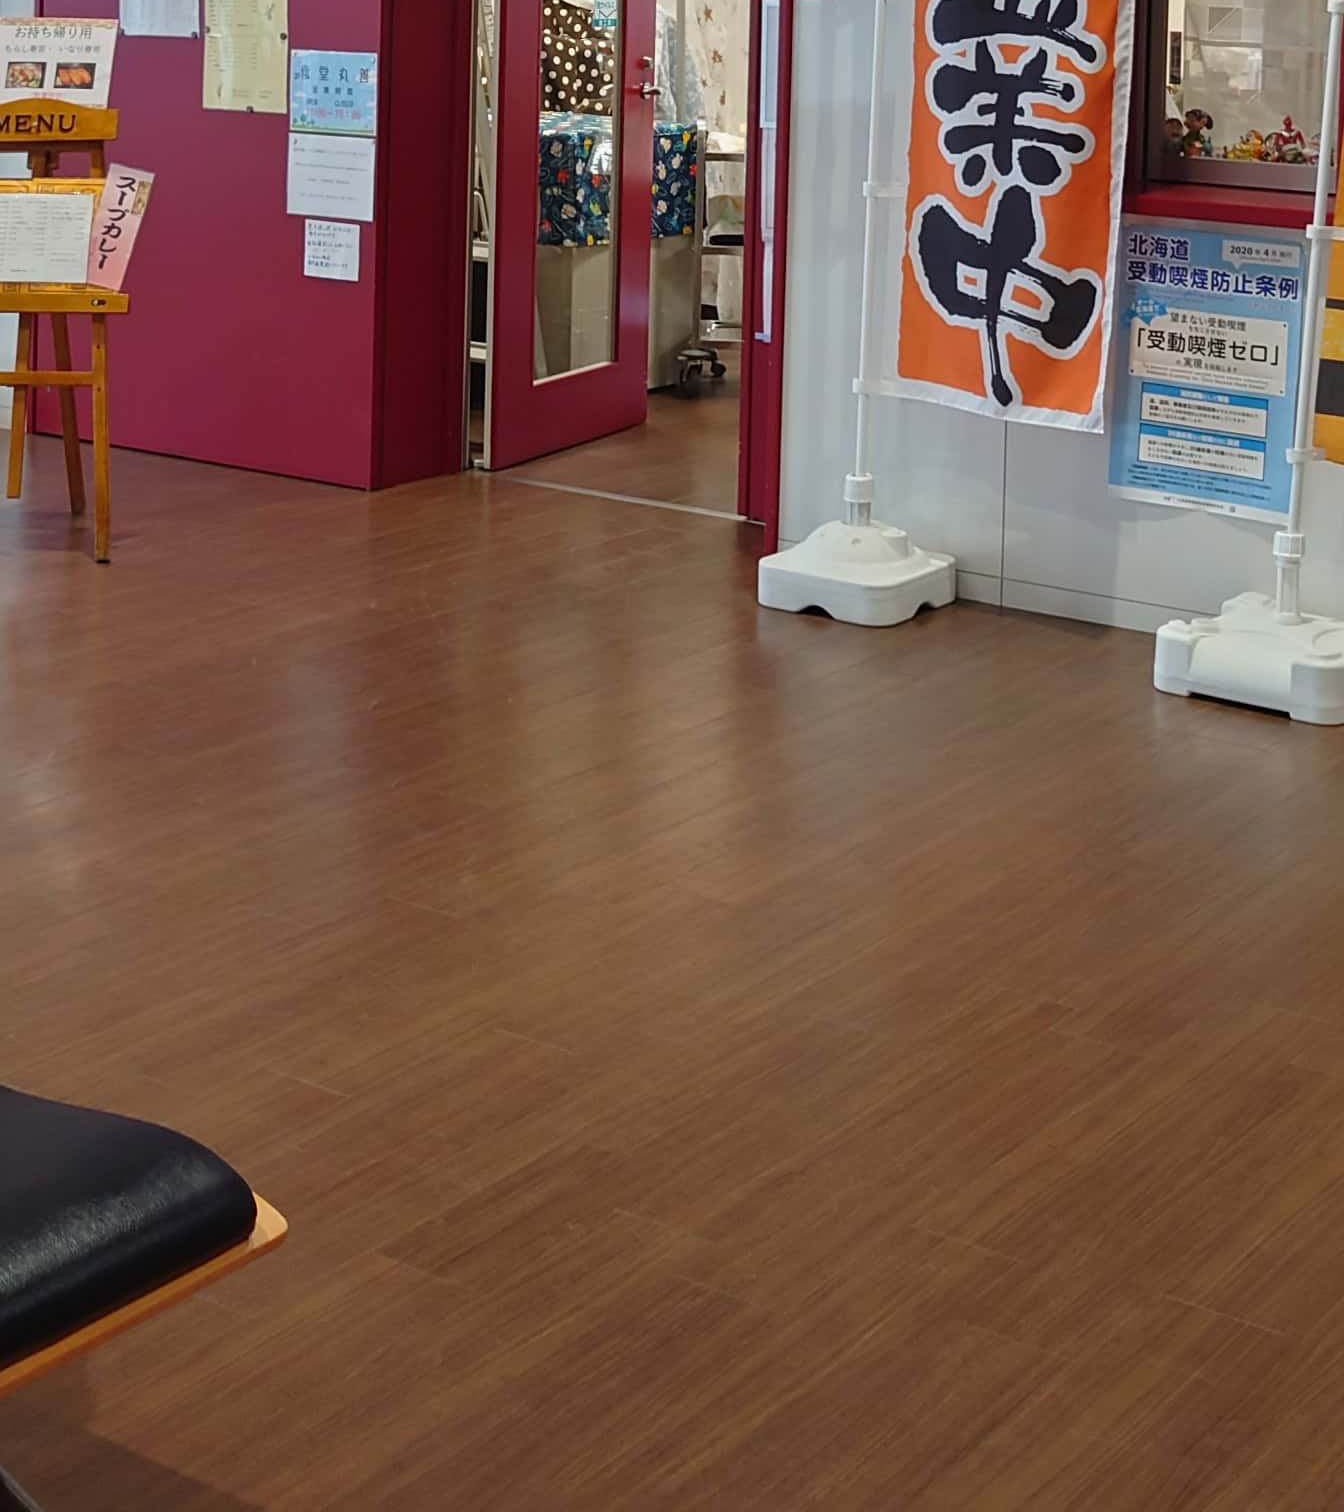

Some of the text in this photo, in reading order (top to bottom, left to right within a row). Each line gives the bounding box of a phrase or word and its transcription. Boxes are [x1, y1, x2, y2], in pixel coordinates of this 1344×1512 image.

[14, 24, 93, 39] お持ち帰り用
[101, 176, 137, 271] スープカレー
[1128, 234, 1190, 262] 北海道
[1126, 260, 1300, 301] 受動喫煙防止条例
[1170, 311, 1247, 332] 望まない受動喫煙
[1137, 328, 1280, 366] 「受動喫煙ゼロ」
